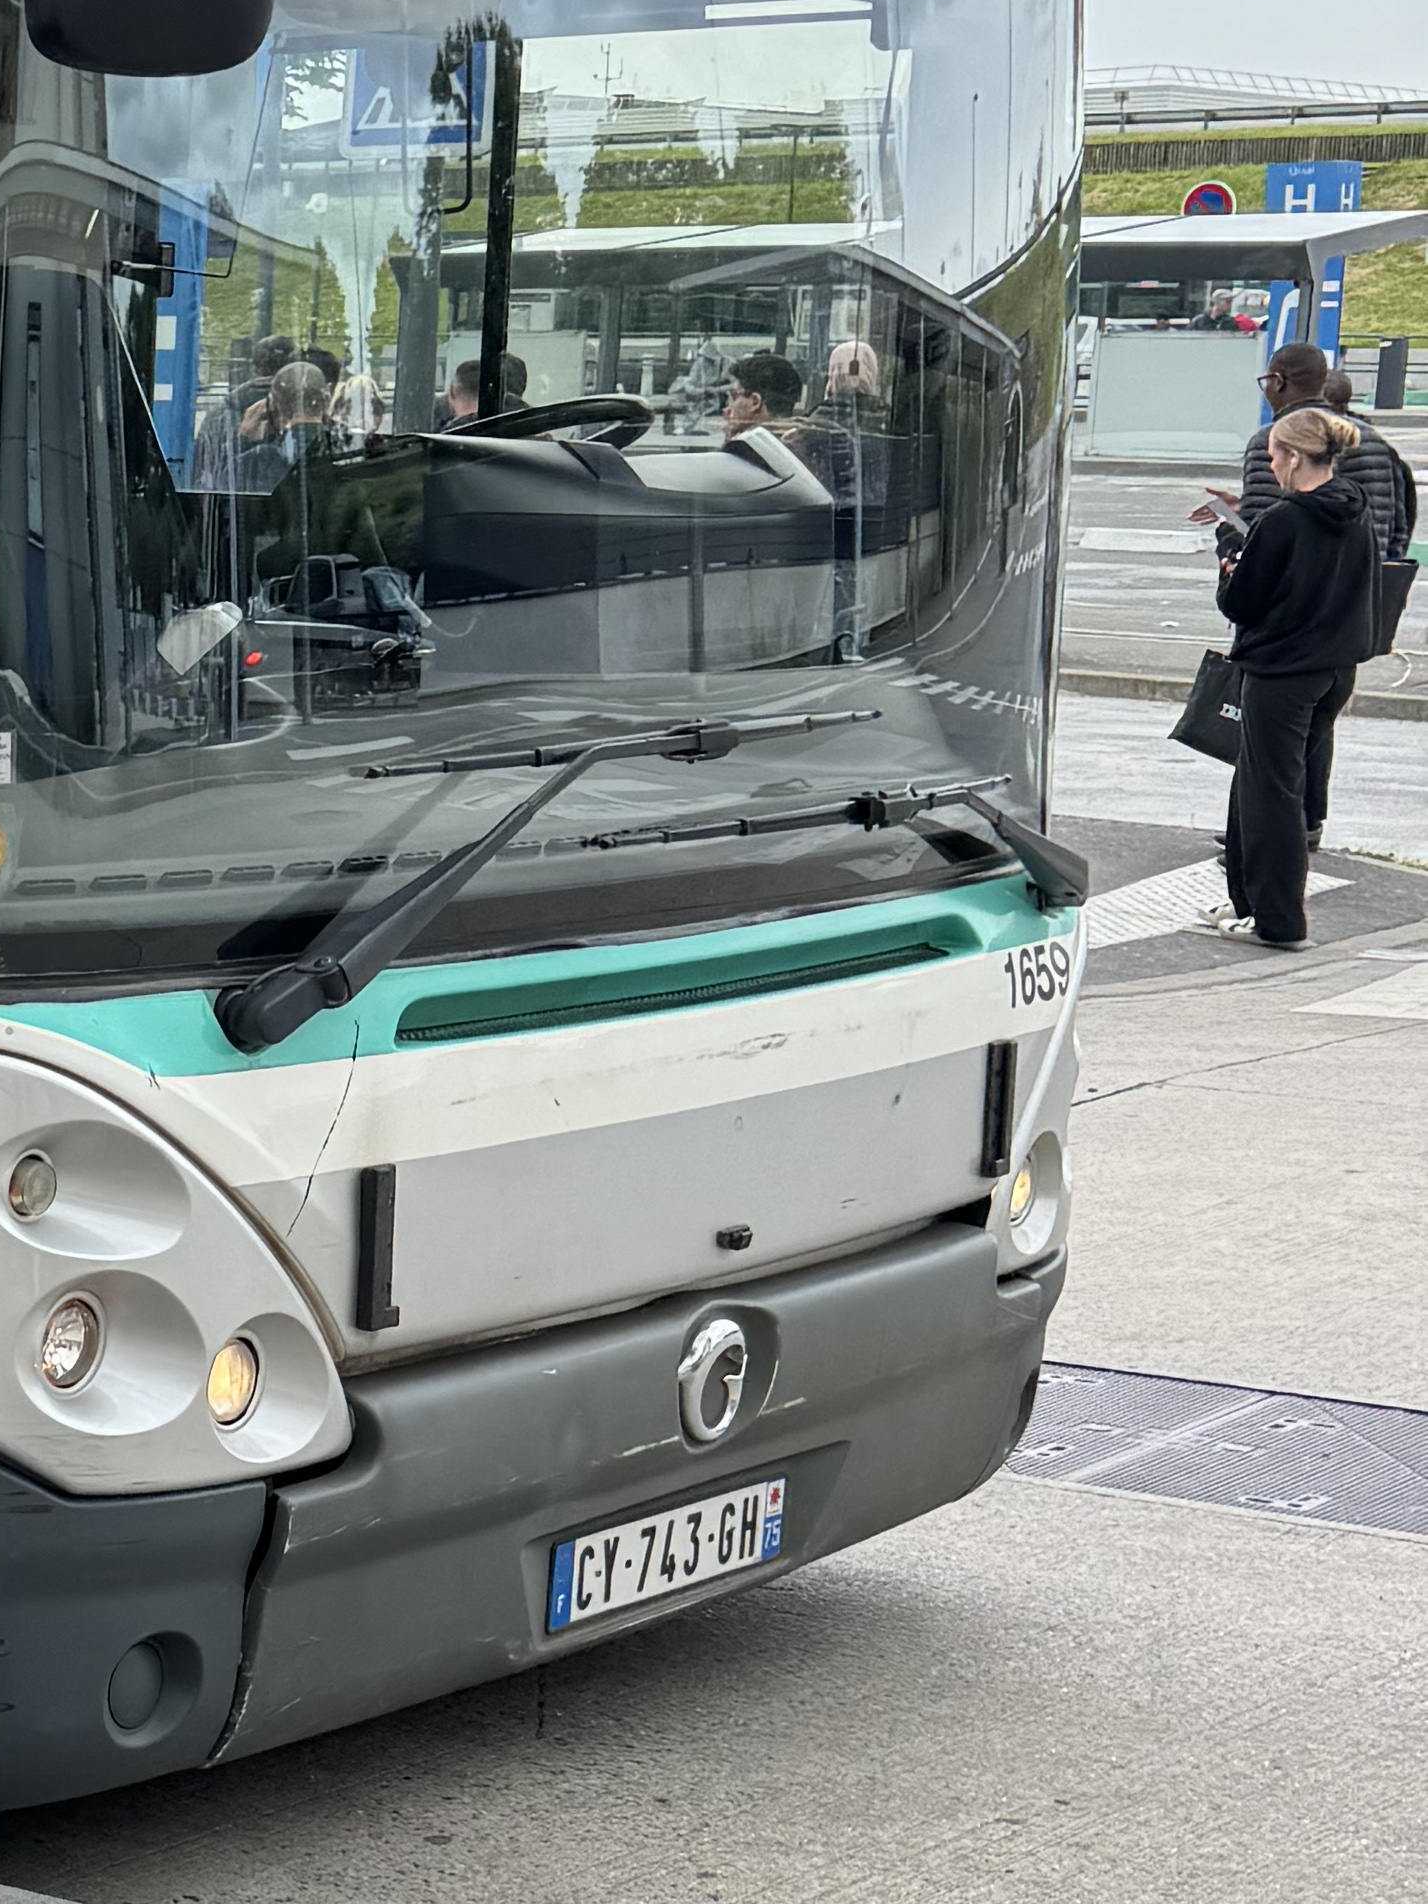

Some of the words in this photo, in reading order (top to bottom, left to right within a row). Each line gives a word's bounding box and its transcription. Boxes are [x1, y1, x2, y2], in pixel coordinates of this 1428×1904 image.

[1285, 183, 1316, 213] H
[1004, 941, 1070, 1008] 1659
[576, 1495, 759, 1611] CY-743-GH
[764, 1518, 782, 1549] 75
